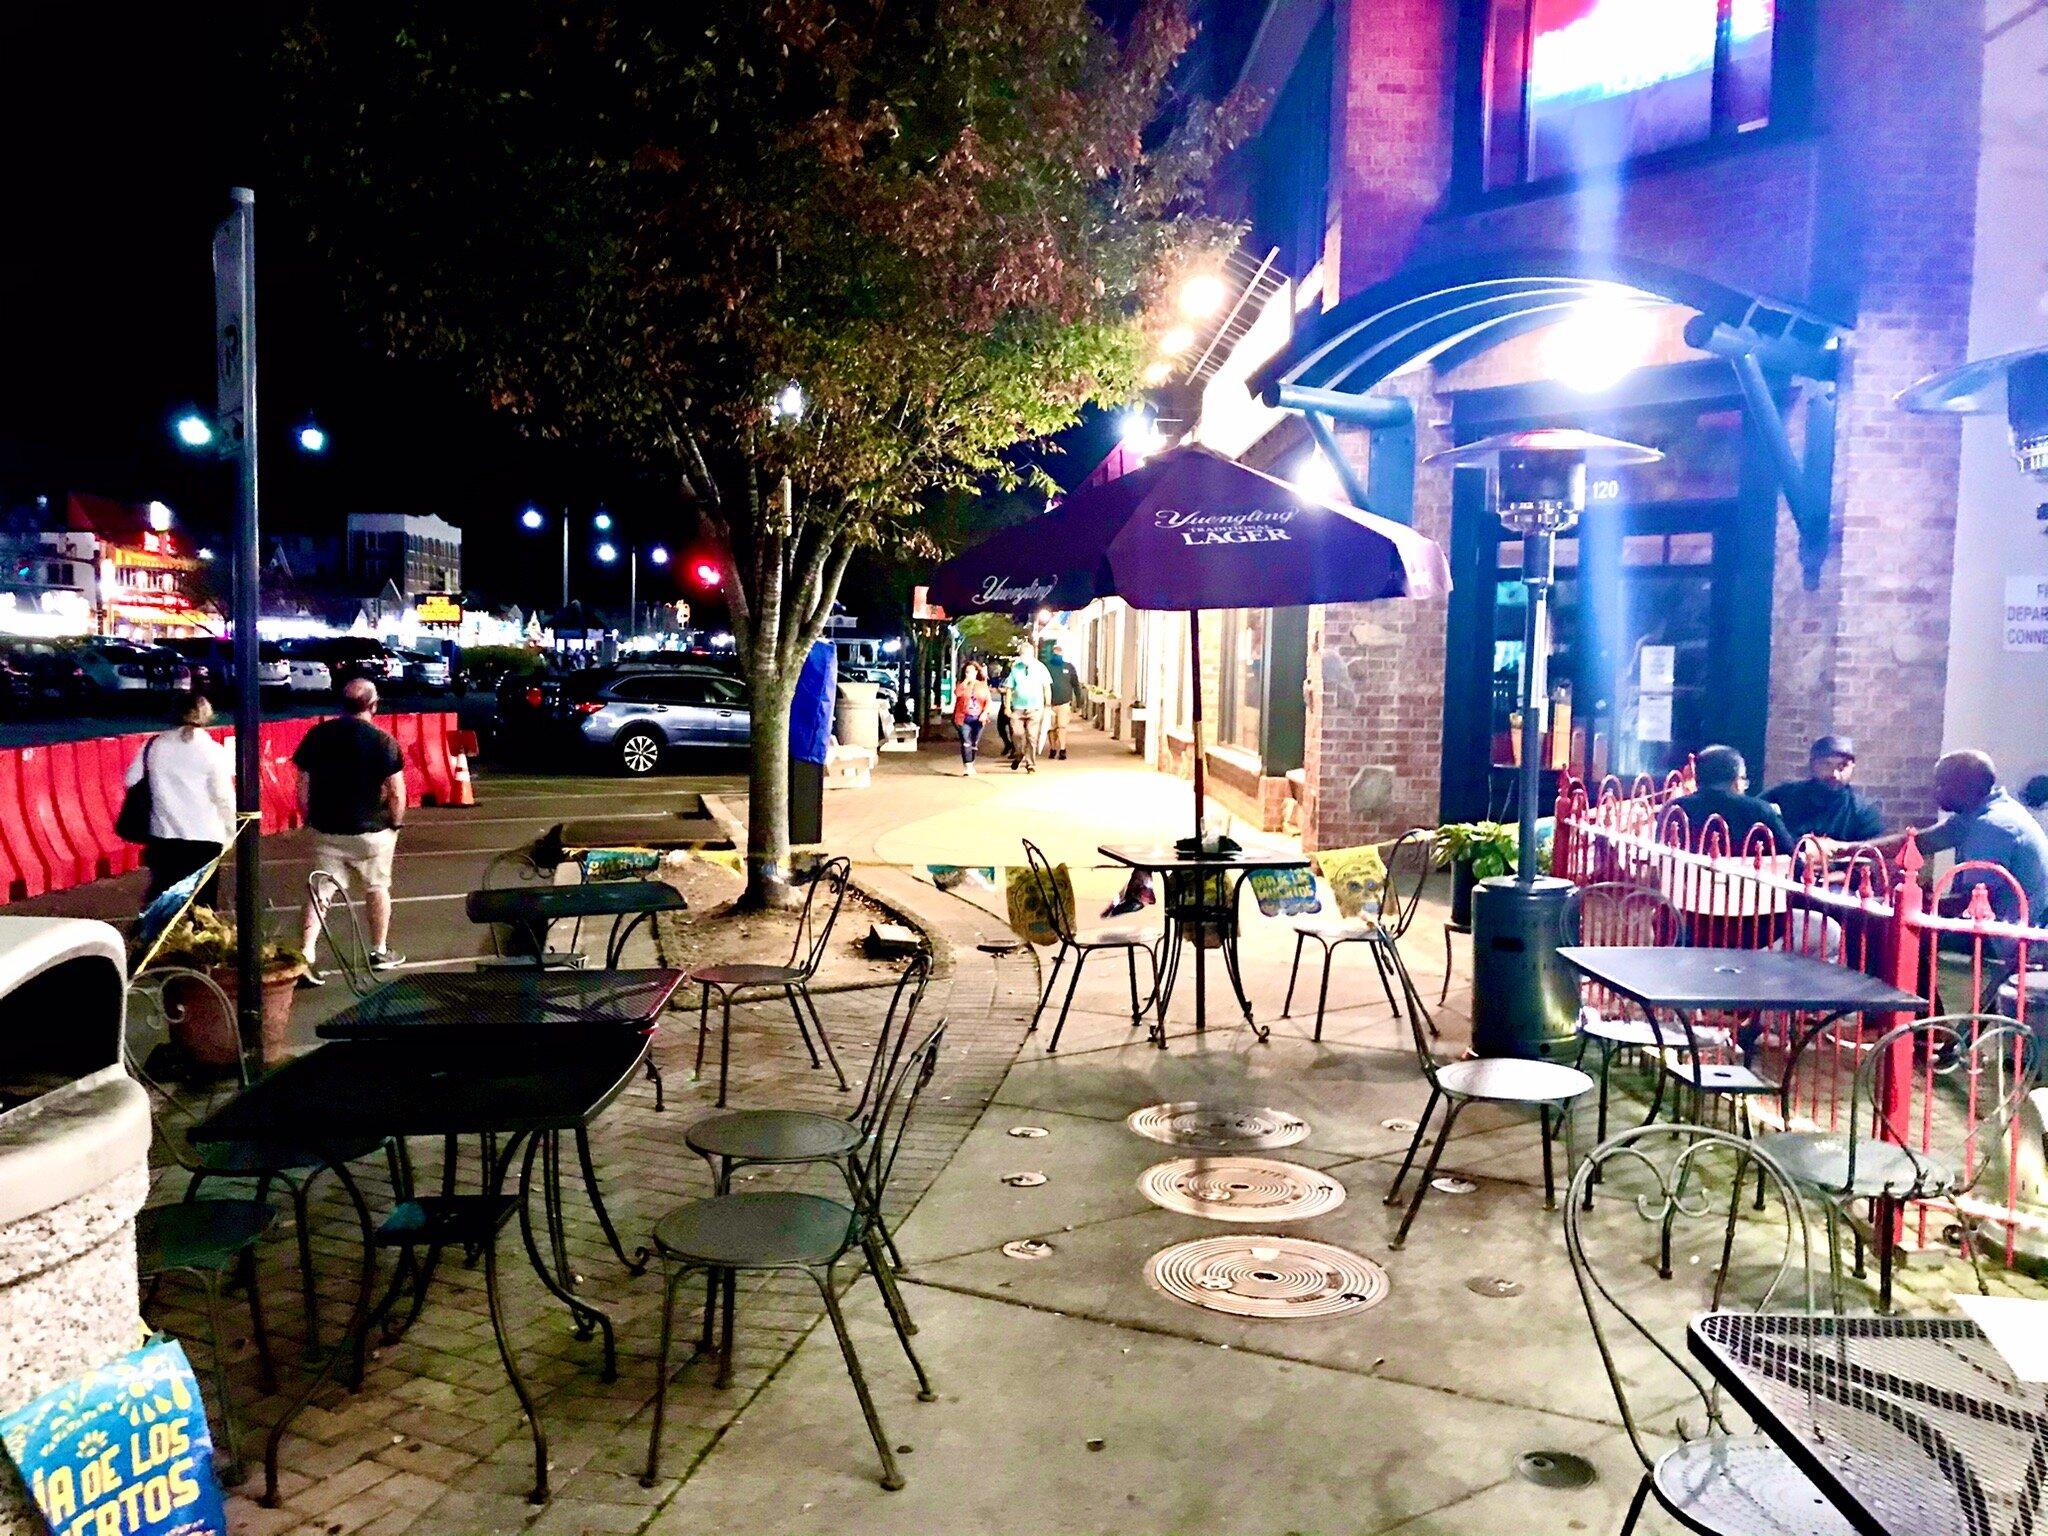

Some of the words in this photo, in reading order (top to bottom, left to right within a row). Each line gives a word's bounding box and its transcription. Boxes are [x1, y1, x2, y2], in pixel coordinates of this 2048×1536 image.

[1592, 480, 1619, 499] 120
[1154, 505, 1300, 529] Yuengling
[1189, 524, 1273, 533] TRADITIONAL
[1181, 528, 1292, 546] LAGER
[971, 574, 1059, 606] Yuengling
[80, 1443, 123, 1505] DE
[130, 1416, 191, 1477] LOS
[61, 1456, 201, 1536] ERTOS
